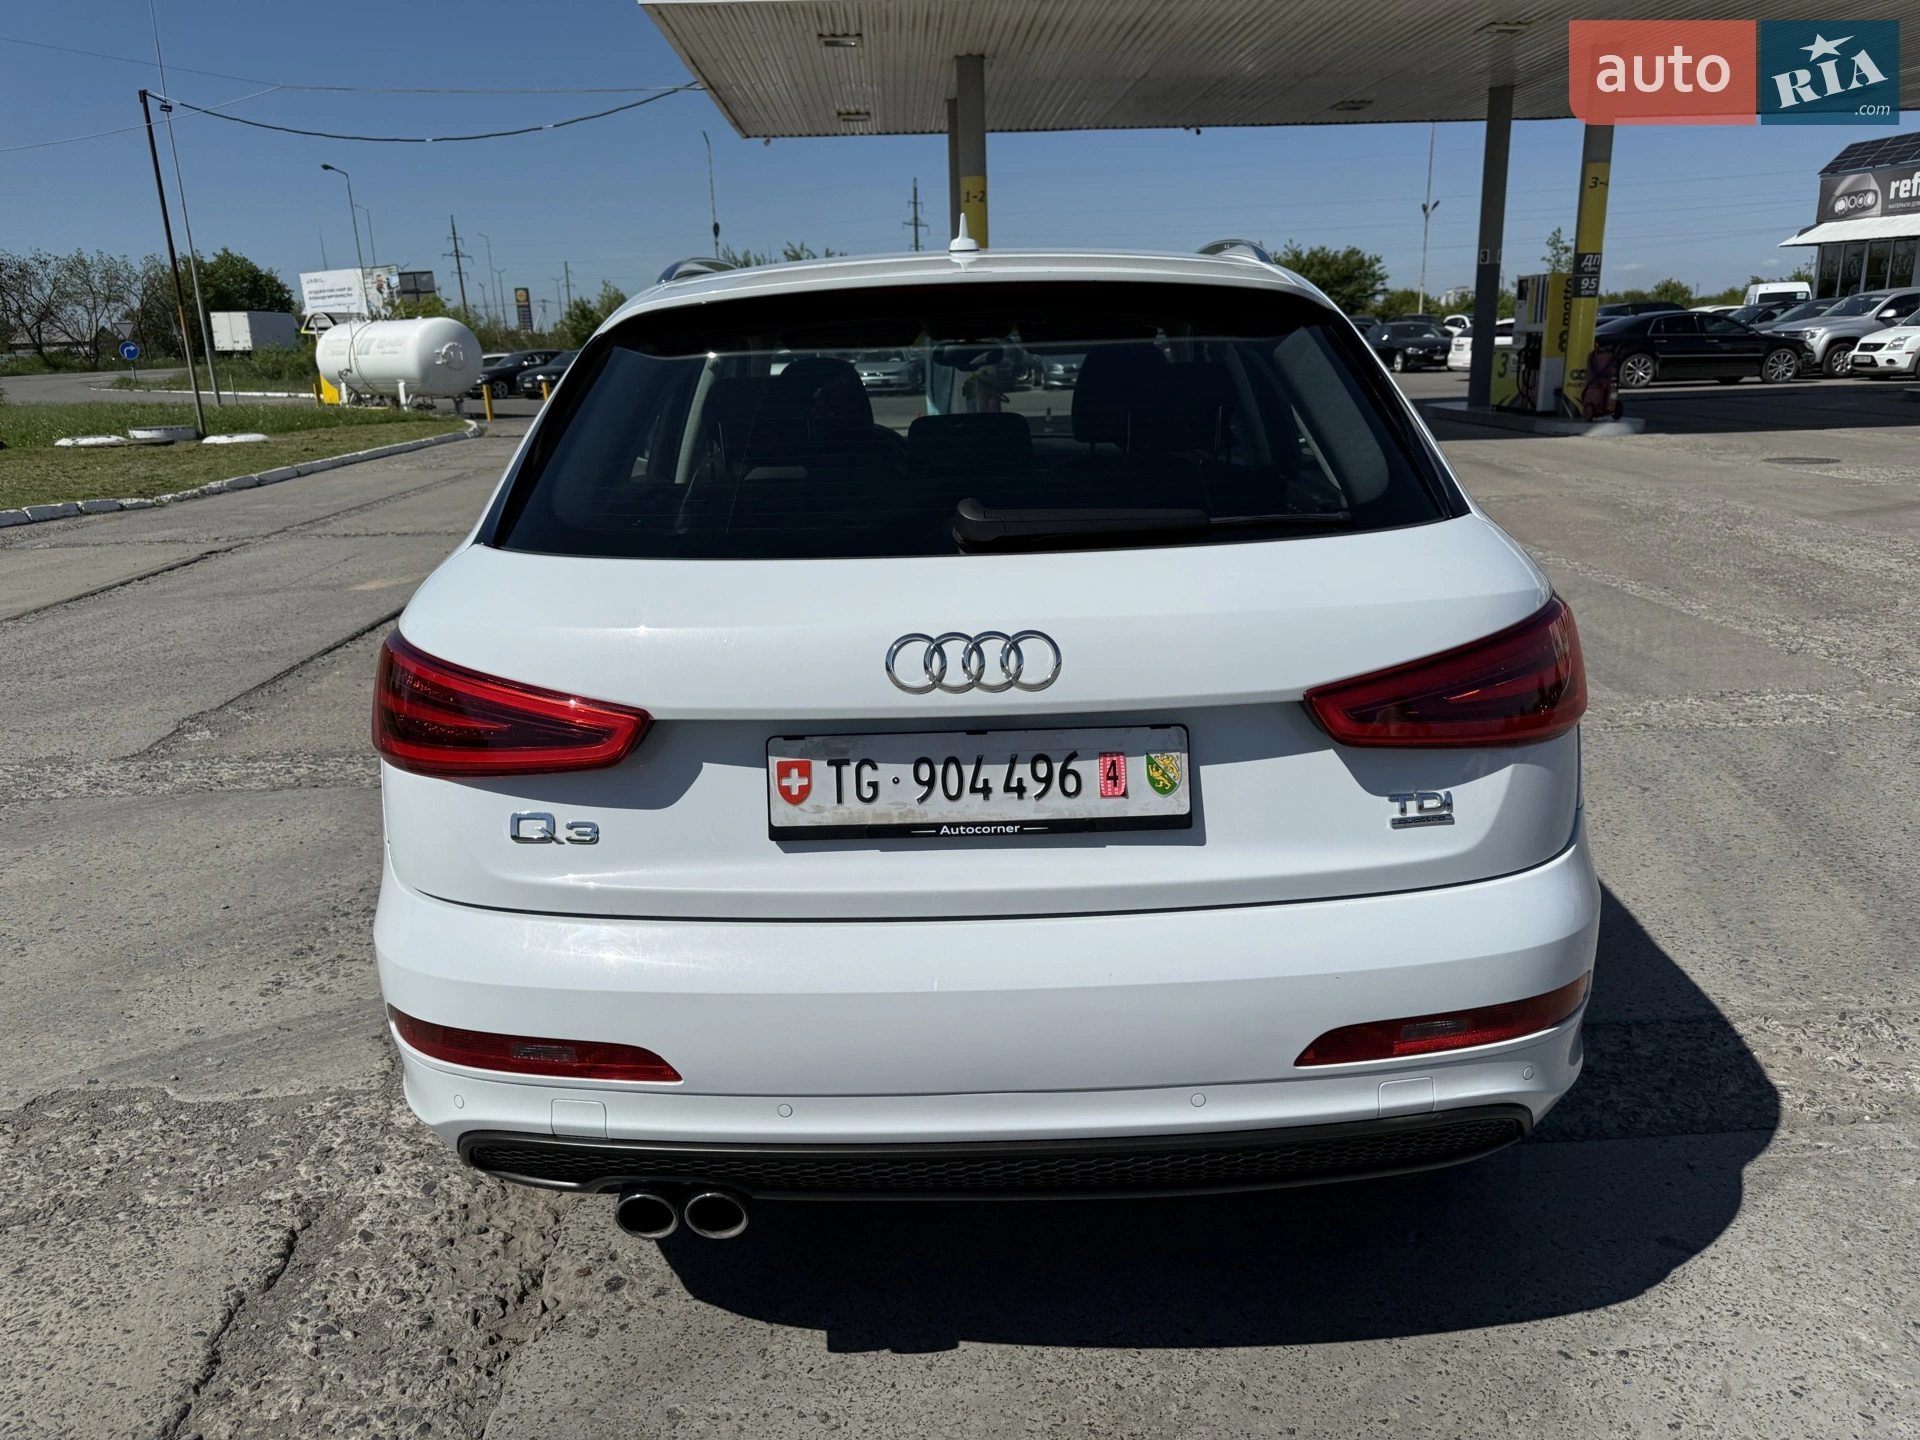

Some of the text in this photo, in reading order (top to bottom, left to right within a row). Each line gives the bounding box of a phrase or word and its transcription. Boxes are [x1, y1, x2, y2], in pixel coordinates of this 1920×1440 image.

[964, 190, 986, 204] 1-2
[1481, 250, 1489, 263] 3
[1580, 277, 1598, 290] 95
[1498, 352, 1509, 378] 3
[826, 758, 880, 804] TG
[1106, 759, 1119, 788] 4
[1388, 791, 1453, 816] TDI
[510, 811, 600, 845] Q3
[939, 823, 1021, 836] Autocorner
[1397, 815, 1446, 825] quattro
